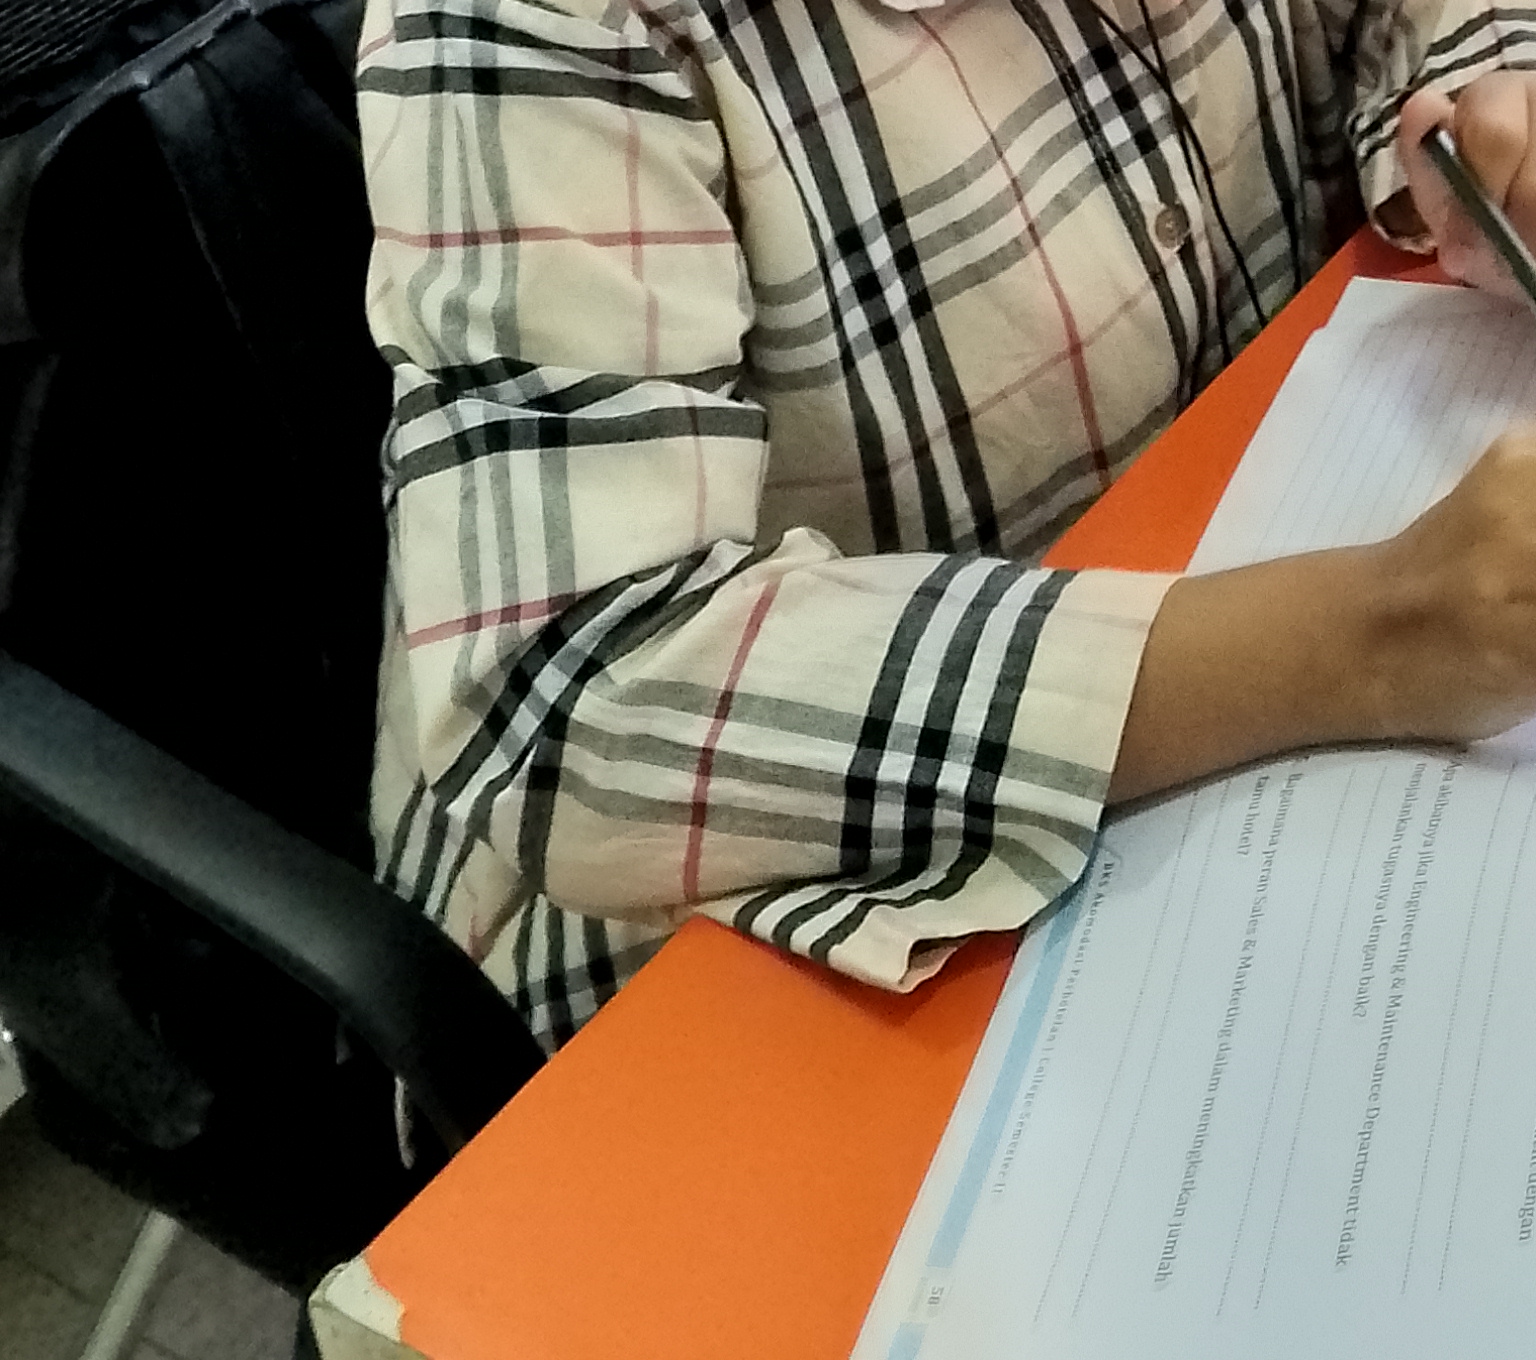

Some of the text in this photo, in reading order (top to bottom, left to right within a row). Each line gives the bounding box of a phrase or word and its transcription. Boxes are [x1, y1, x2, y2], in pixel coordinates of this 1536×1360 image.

[1235, 776, 1271, 856] tamu hotel?
[1421, 784, 1452, 848] akibatnya
[1350, 763, 1429, 1018] menjalankan tugasnya dengan baik?
[1413, 850, 1436, 877] jika
[1072, 893, 1106, 964] Akomodasi
[1389, 880, 1429, 974] Engineering
[1045, 969, 1082, 1042] Perhotelan
[1389, 976, 1407, 990] &
[1152, 773, 1305, 1284] Bagaimana peran Sales & Marketing dalam meningkatkan jumlah
[1367, 994, 1405, 1103] Maintenance
[1021, 1057, 1050, 1108] College
[997, 1112, 1032, 1177] Semester
[1344, 1106, 1382, 1215] Department
[1333, 1218, 1357, 1267] tidak
